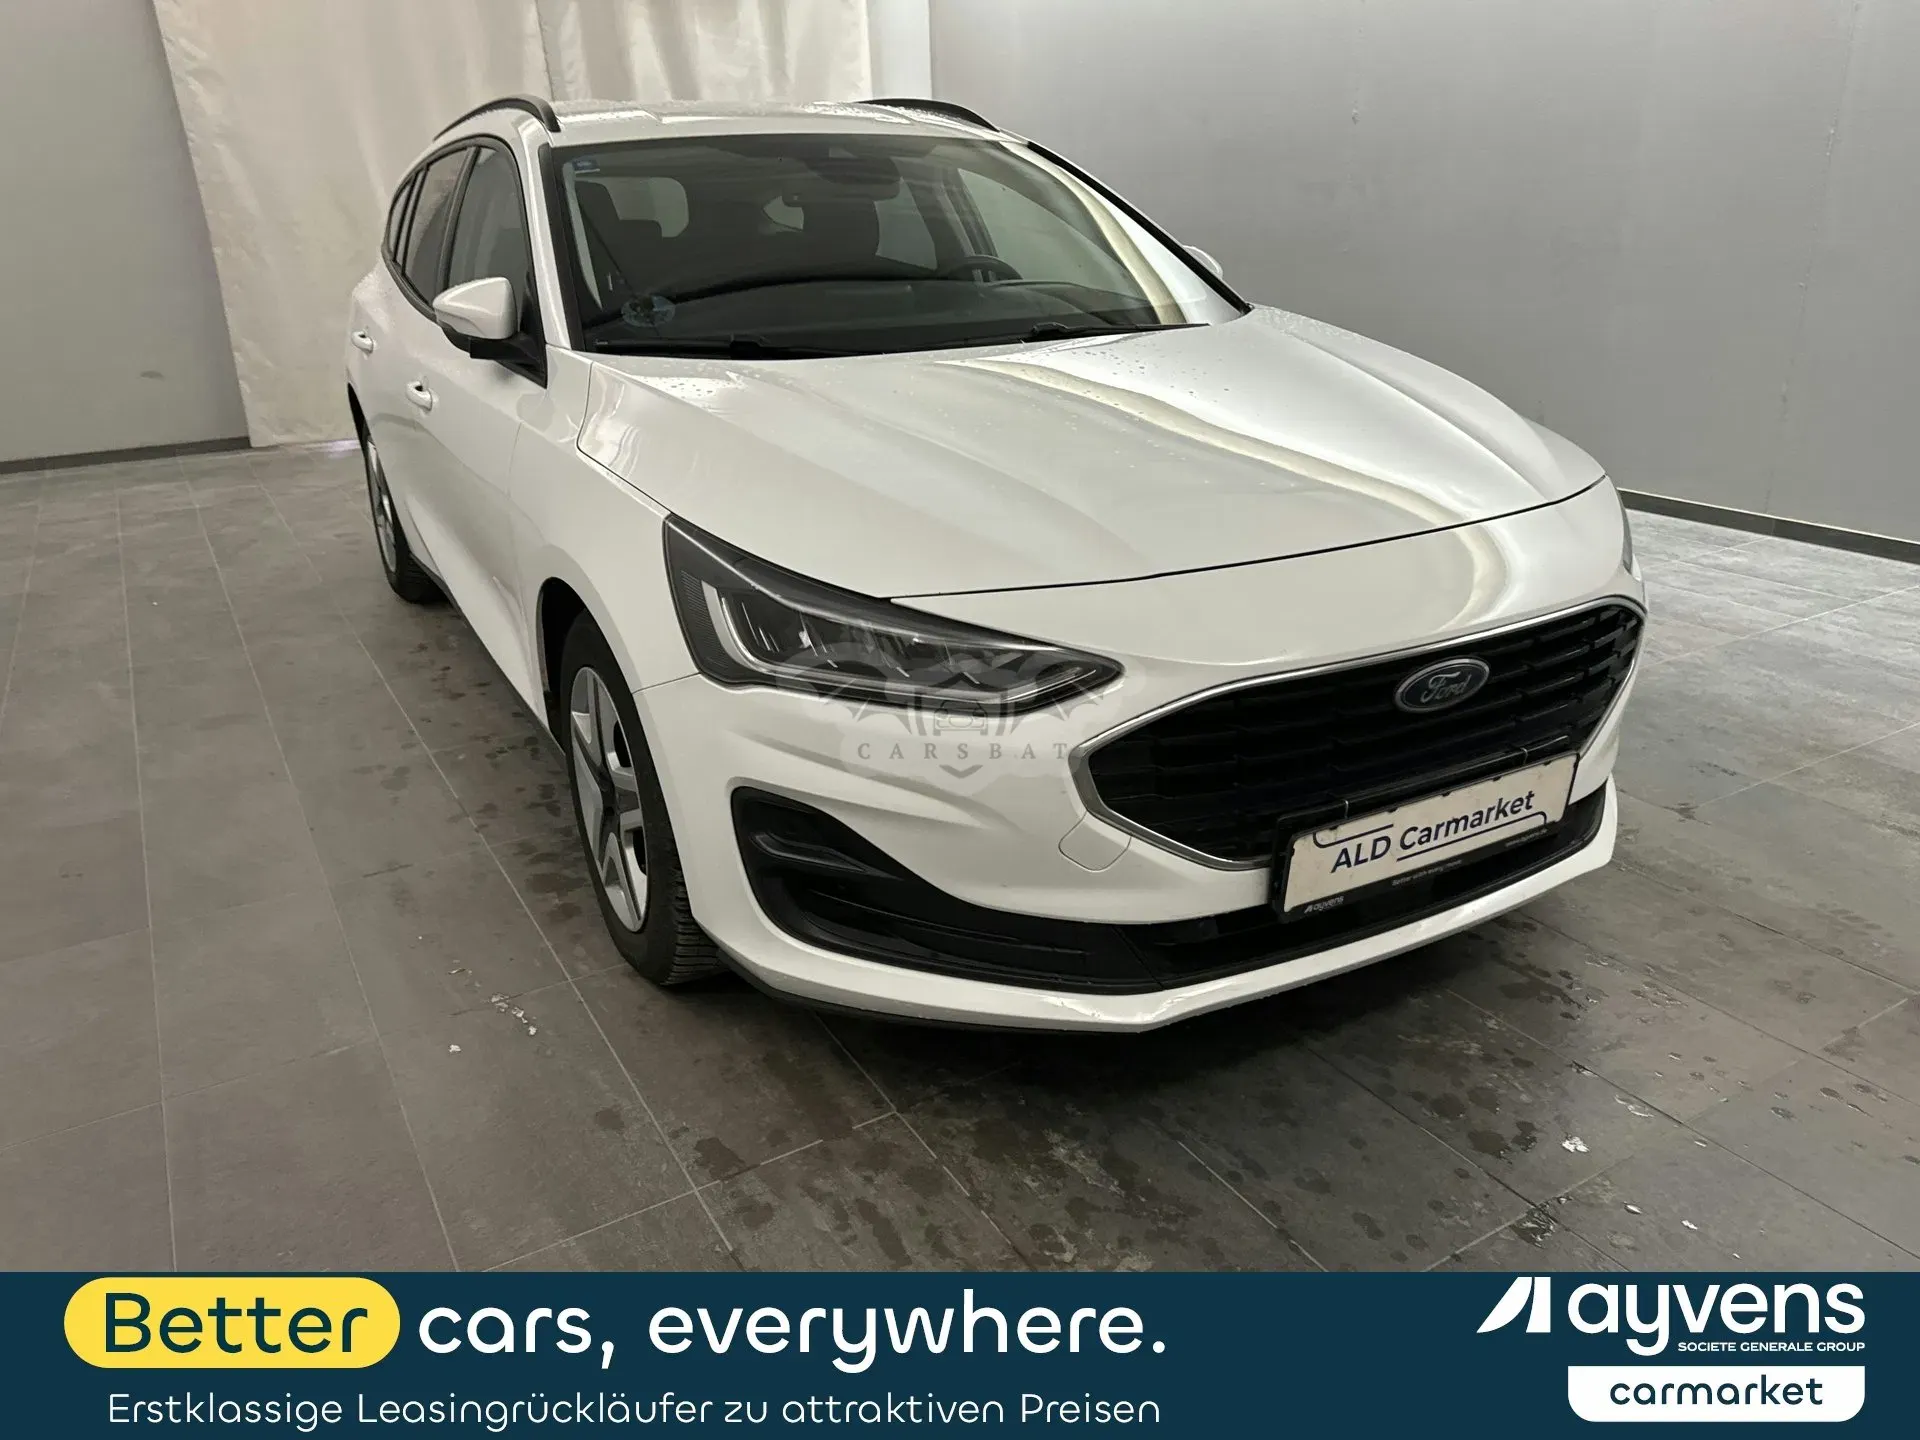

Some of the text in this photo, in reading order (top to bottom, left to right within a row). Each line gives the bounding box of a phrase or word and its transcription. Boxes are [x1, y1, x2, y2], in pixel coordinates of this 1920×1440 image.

[1421, 671, 1472, 703] Ford
[1331, 790, 1536, 874] ALD Carmarket
